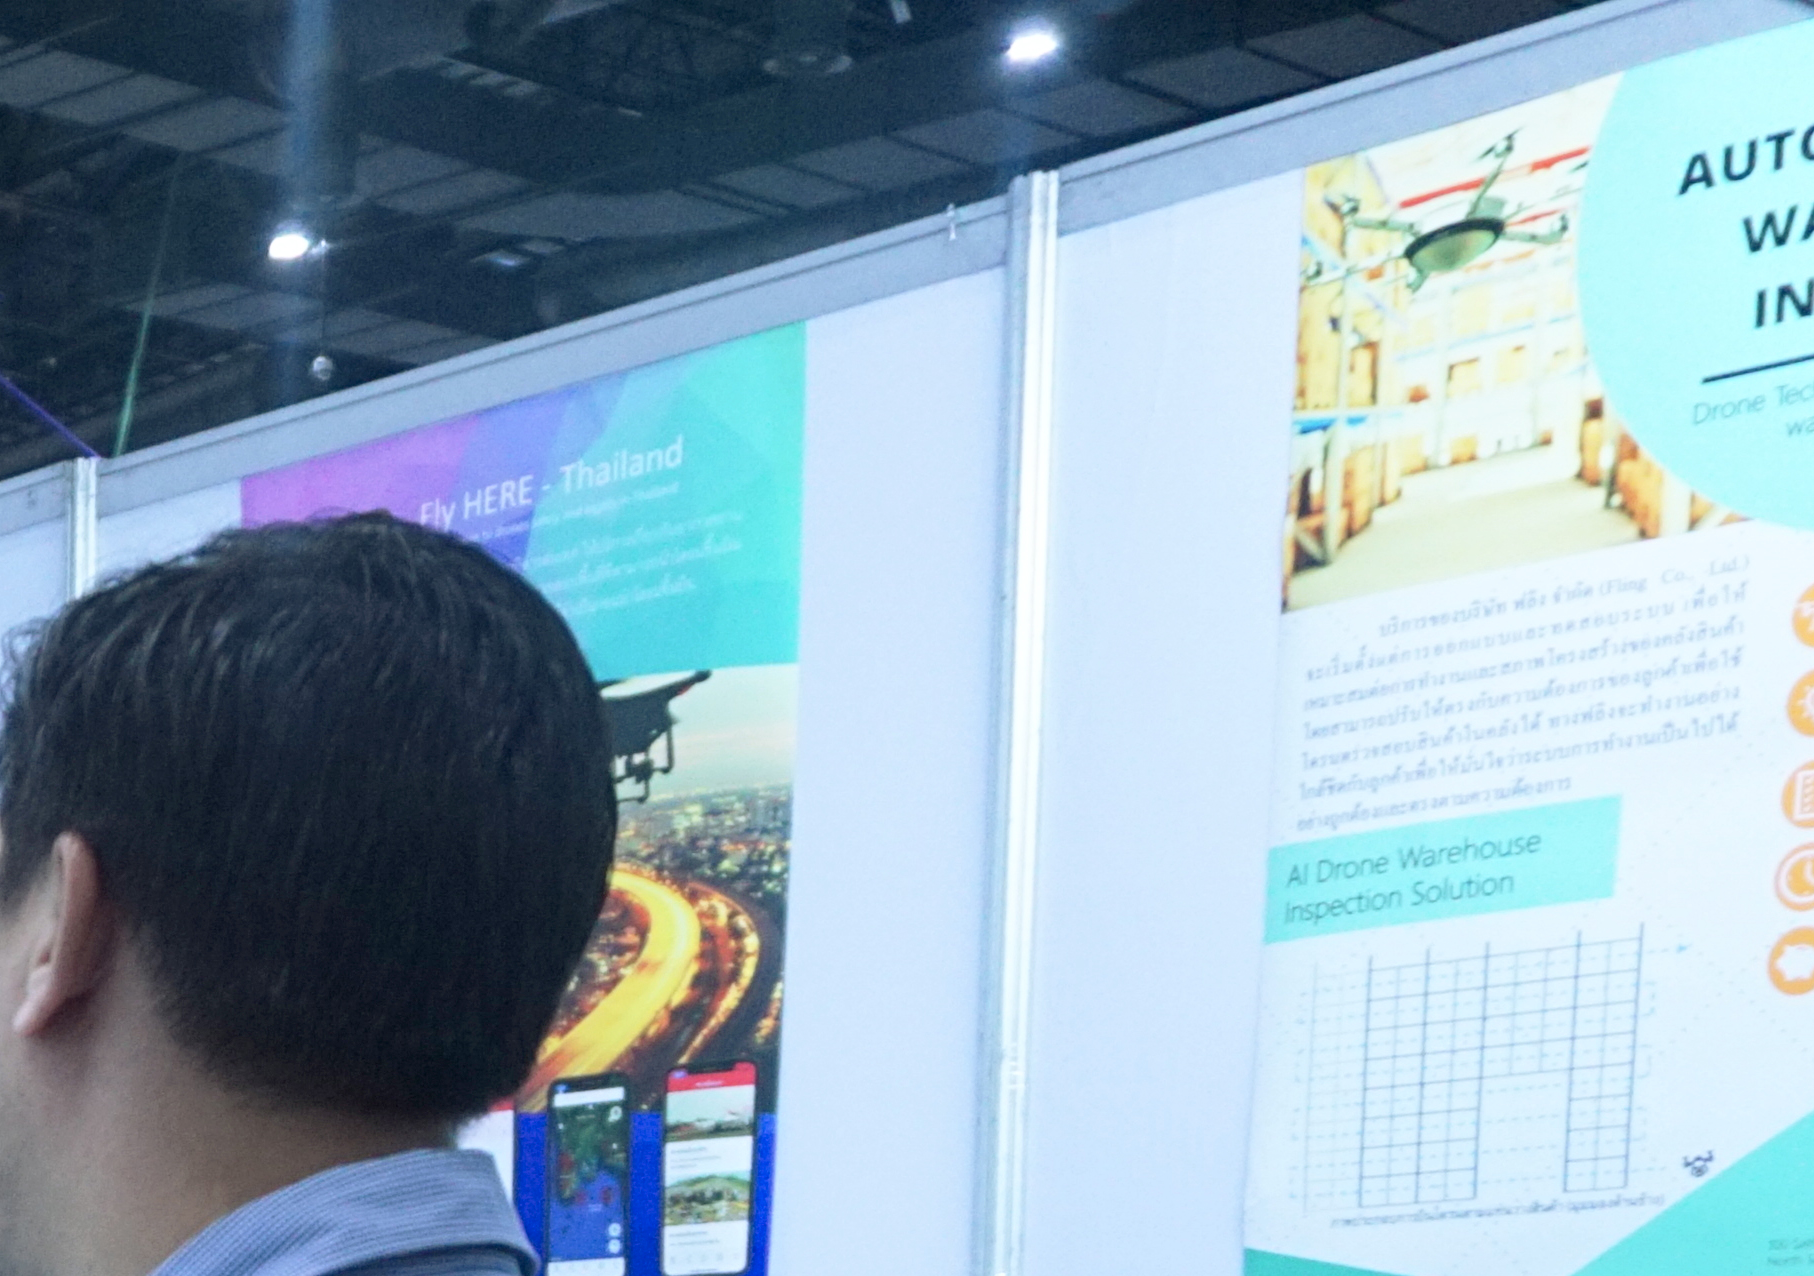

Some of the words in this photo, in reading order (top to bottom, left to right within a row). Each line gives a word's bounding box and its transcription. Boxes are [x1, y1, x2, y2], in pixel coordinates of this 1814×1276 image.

[1693, 394, 1766, 426] Drone
[463, 475, 534, 520] HERE
[560, 434, 683, 494] Thailand
[1286, 865, 1308, 888] AI
[1317, 854, 1389, 884] Drone
[1399, 832, 1541, 870] Warehouse
[1284, 889, 1402, 925] Inspection
[1412, 873, 1514, 906] Solution
